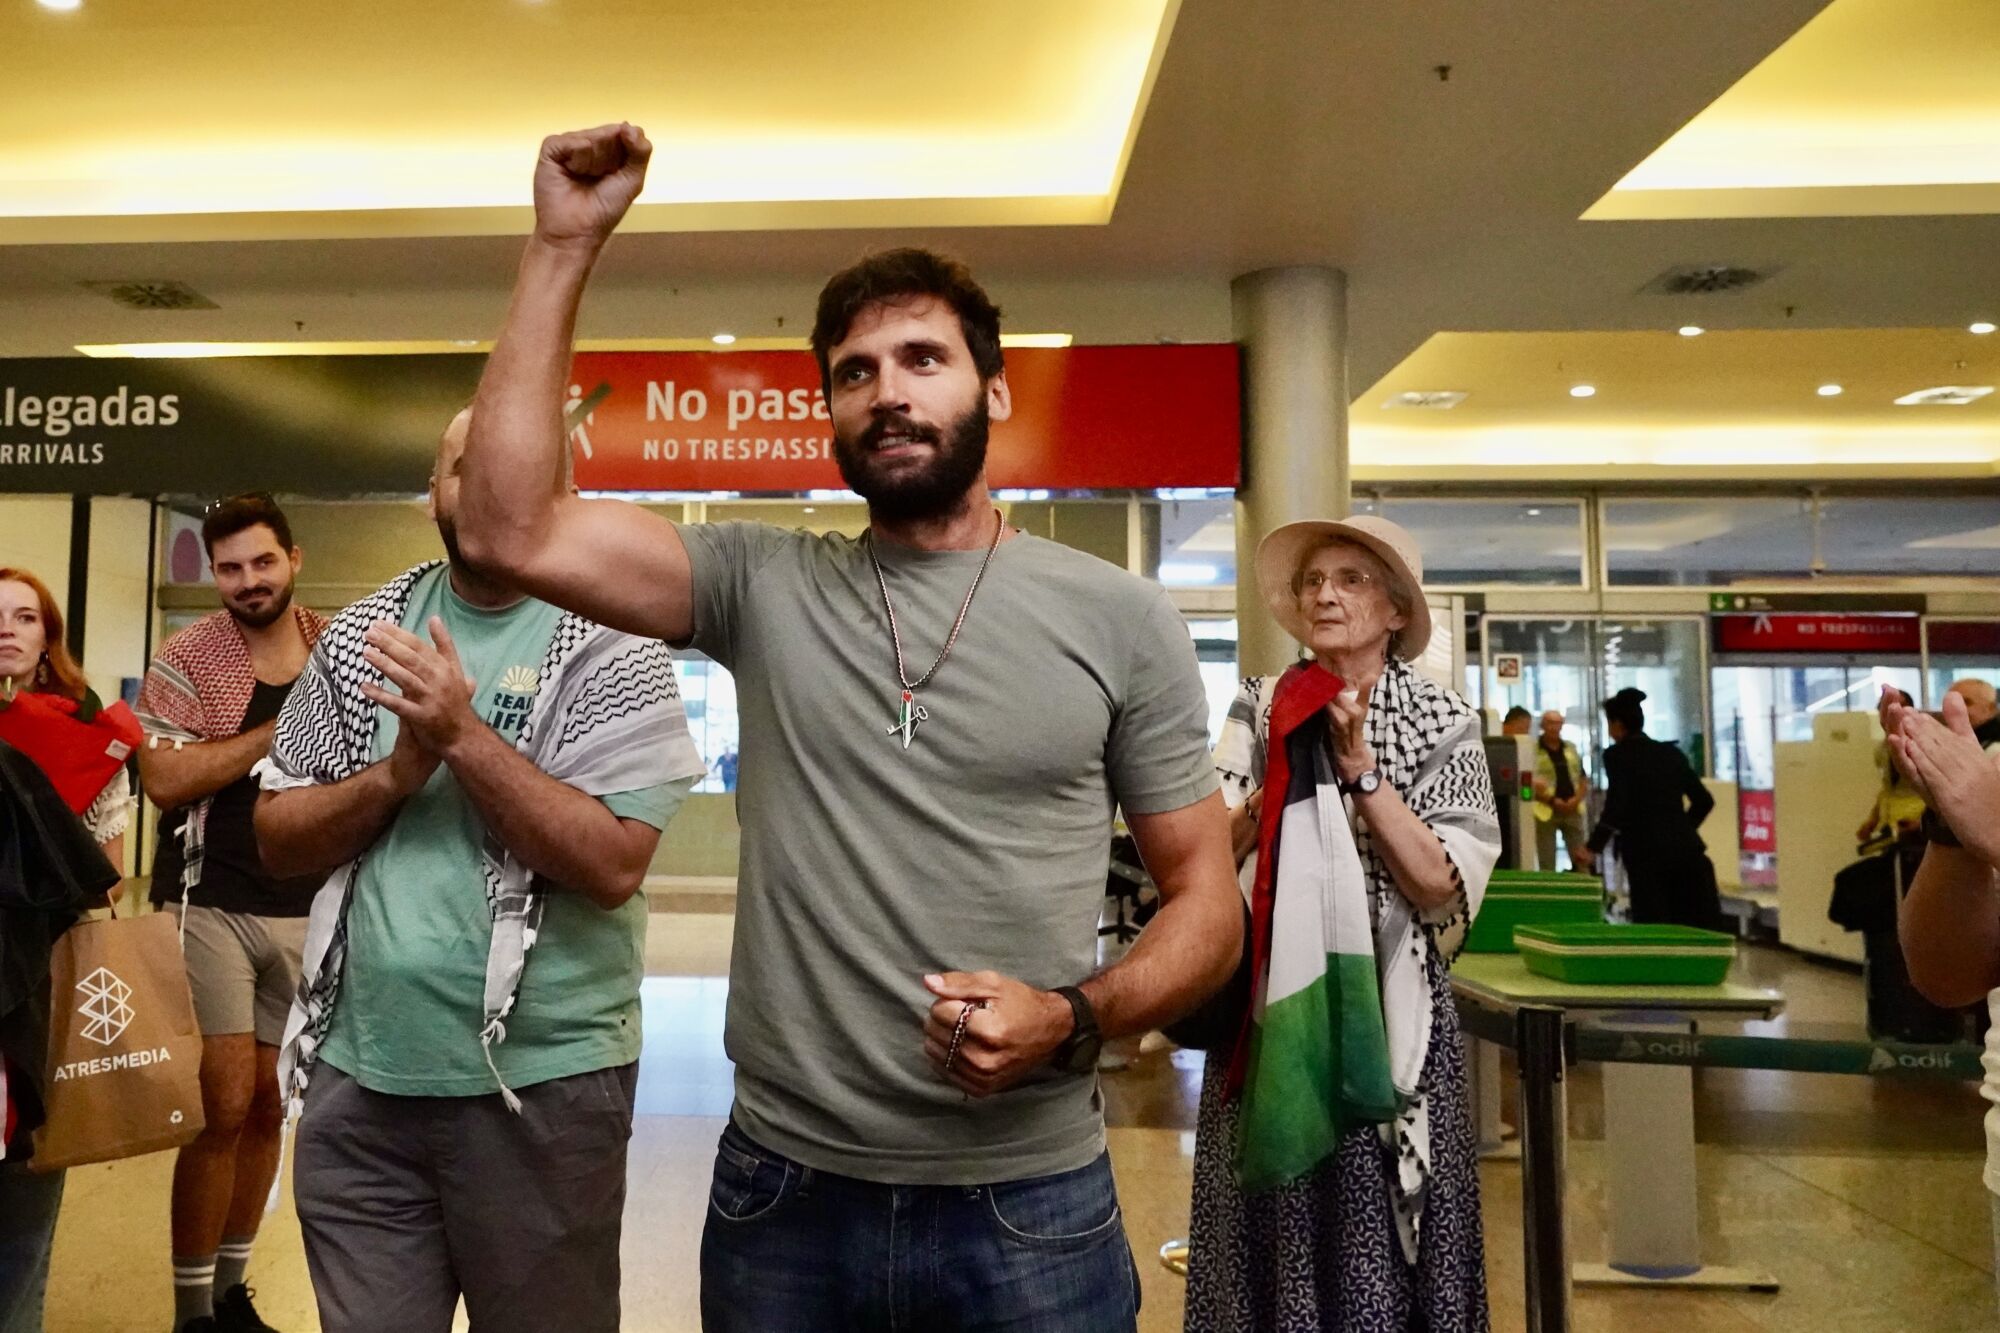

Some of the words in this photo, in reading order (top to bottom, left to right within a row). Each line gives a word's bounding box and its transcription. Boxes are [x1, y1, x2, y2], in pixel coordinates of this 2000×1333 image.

[0, 385, 180, 437] legadas
[646, 381, 708, 421] No
[728, 388, 831, 431] pasa
[0, 443, 104, 464] RRIVALS
[643, 439, 679, 460] NO
[687, 438, 831, 460] TRESPASSI
[487, 710, 528, 732] IF
[53, 1046, 171, 1083] ATRESMEDIA
[1898, 1051, 1952, 1069] adif
